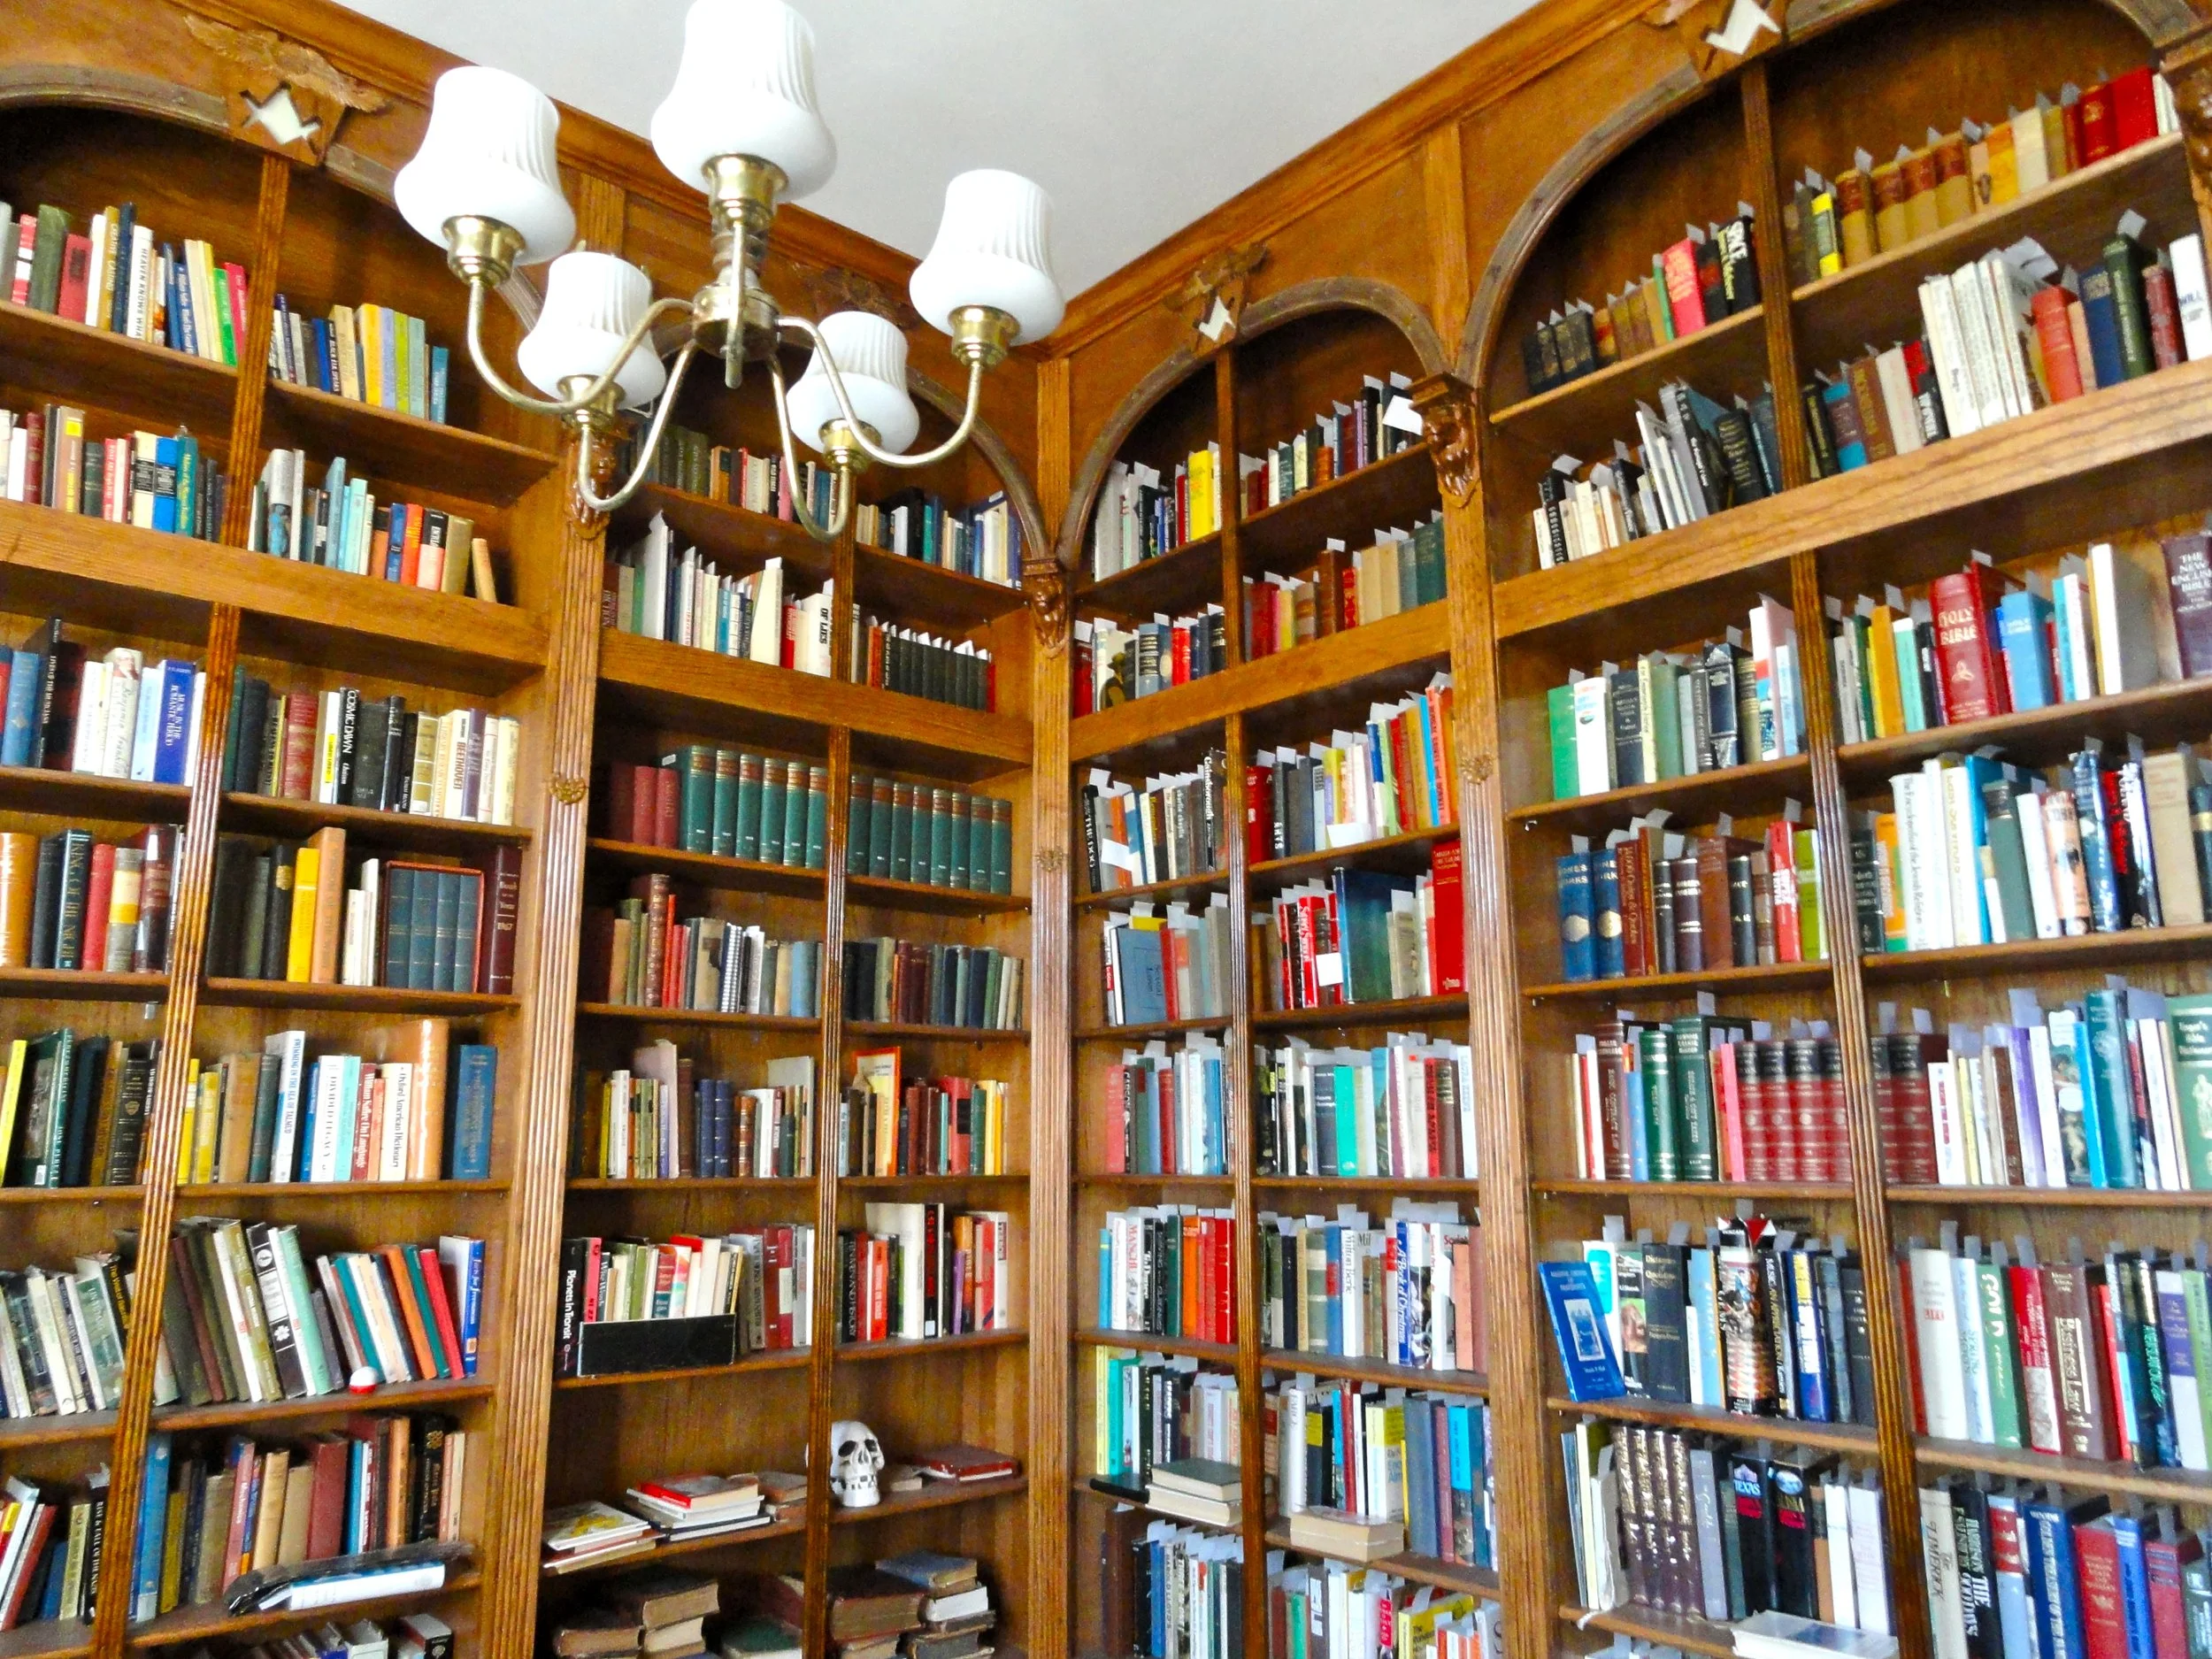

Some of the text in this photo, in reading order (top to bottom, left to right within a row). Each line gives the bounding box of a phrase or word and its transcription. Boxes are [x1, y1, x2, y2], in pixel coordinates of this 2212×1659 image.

[107, 224, 119, 255] CREATIVE
[105, 260, 117, 291] CASTING
[138, 249, 147, 280] HEAVEN
[136, 283, 145, 315] KNOWS
[819, 608, 828, 644] OF LIES
[1938, 606, 1975, 628] HOLY
[1939, 625, 1978, 645] BIBLE
[168, 685, 179, 719] ROMANTIC
[173, 693, 186, 739] MUSIC IN THE
[342, 690, 356, 754] COSMIC DAWN
[113, 736, 129, 773] Franklin
[453, 741, 466, 788] BEETHOVEN
[1204, 757, 1214, 820] Gainsborough
[1911, 866, 1923, 891] Jewish
[61, 843, 84, 958] KING OF THE NIGHT
[325, 897, 335, 910] OF
[1913, 891, 1924, 924] Religion
[289, 1038, 301, 1068] SWIMMING
[284, 1110, 295, 1133] TALMUD
[323, 1075, 337, 1157] DIVIDED LEGACY
[355, 1072, 374, 1167] William Safire On Language
[392, 1072, 406, 1167] Oxford American Dictionary
[1607, 1069, 1619, 1148] BASIC CONTRACT LAW
[1345, 1232, 1356, 1294] Milton Berle
[1398, 1260, 1407, 1282] Book
[565, 1270, 577, 1301] Planets
[598, 1281, 607, 1306] Words
[563, 1310, 574, 1338] Transit
[1397, 1294, 1409, 1341] Christmas
[1769, 1301, 1782, 1361] APPRECIATION
[2059, 1317, 2082, 1412] Business Law
[95, 1502, 104, 1517] RISE
[93, 1529, 102, 1545] FALL
[91, 1559, 100, 1572] THE
[1925, 1521, 1945, 1601] LIMERICK
[1973, 1576, 1991, 1609] THE
